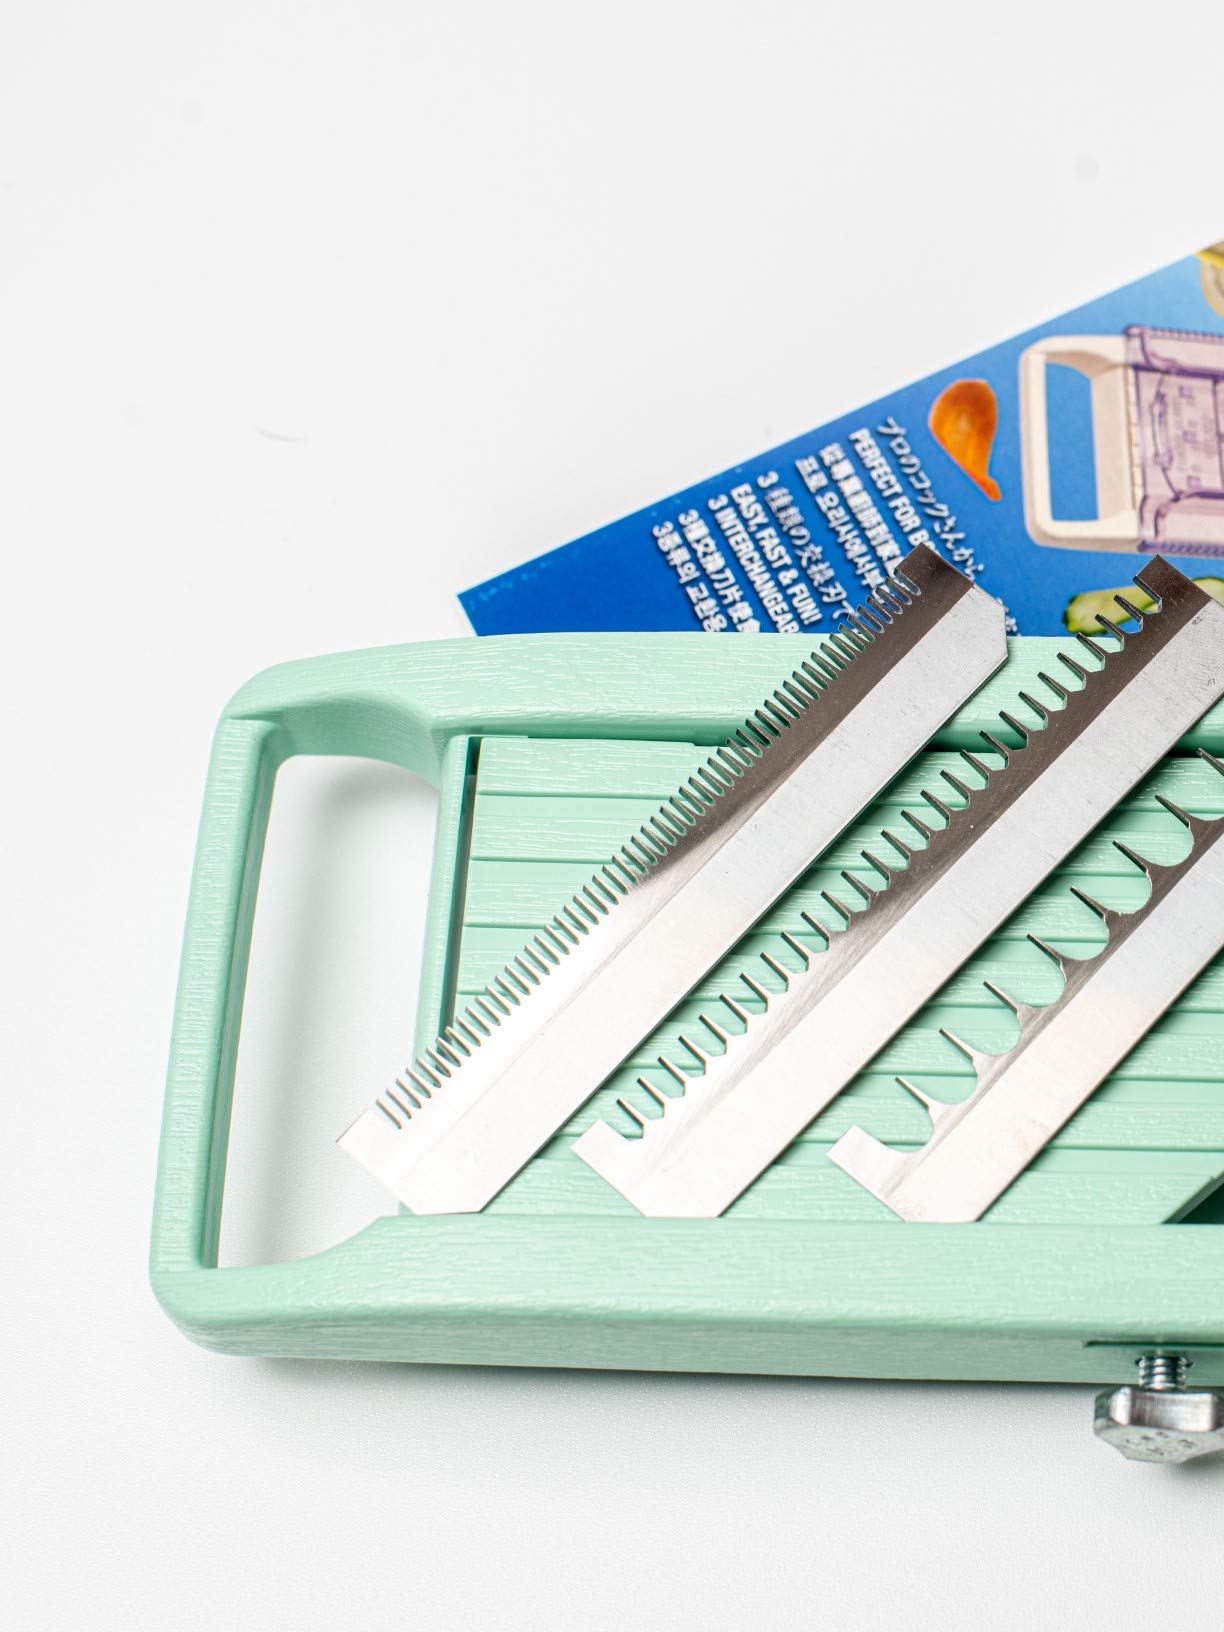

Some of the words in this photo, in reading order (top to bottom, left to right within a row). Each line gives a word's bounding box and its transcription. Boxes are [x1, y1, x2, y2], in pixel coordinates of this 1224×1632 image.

[757, 471, 779, 488] 3
[795, 456, 828, 494] 프로
[849, 427, 904, 498] PERFECT
[888, 495, 921, 533] FOR
[708, 494, 728, 511] 3
[730, 483, 768, 532] EASY,
[714, 507, 799, 633] INTERCHANGEAB
[755, 526, 791, 576] FAST
[777, 567, 799, 587] &
[785, 581, 822, 626] FUN!
